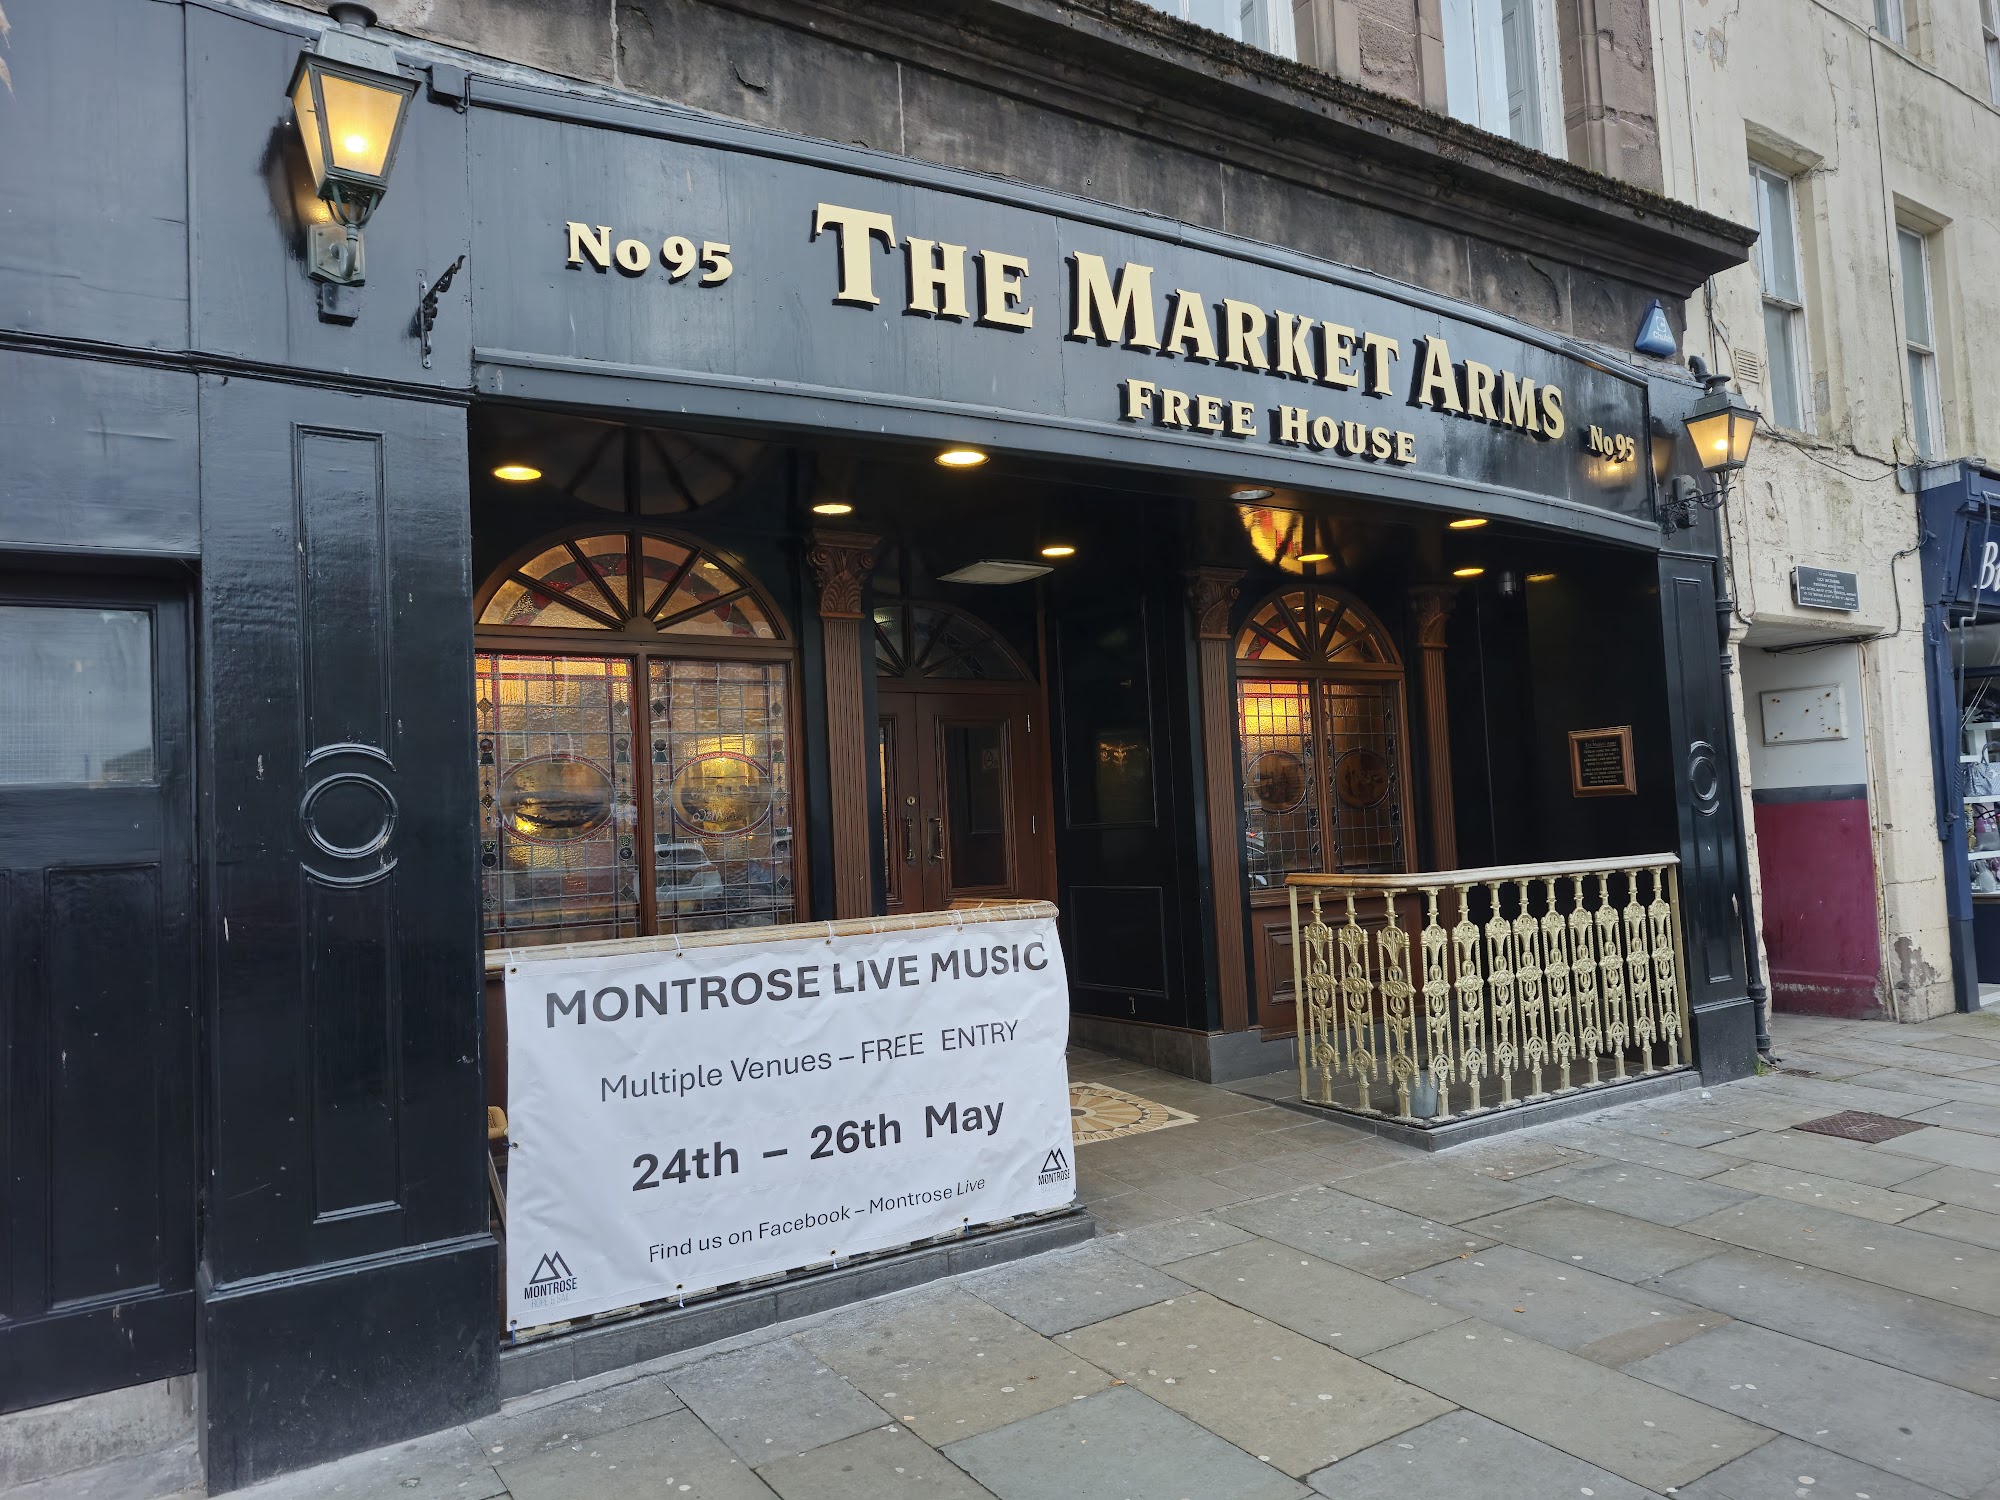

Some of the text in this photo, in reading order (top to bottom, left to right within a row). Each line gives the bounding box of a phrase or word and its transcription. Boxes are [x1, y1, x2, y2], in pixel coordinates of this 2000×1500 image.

[569, 221, 733, 282] No 95
[816, 203, 1566, 440] THE MARKET ARMS
[1652, 331, 1673, 343] Chubb
[1126, 379, 1417, 464] FREE HOUSE
[1590, 424, 1635, 462] No 95
[546, 942, 1049, 1029] MONTROSE LIVE MUSIC
[600, 1064, 722, 1102] Multiple
[731, 1053, 832, 1082] Venues
[861, 1033, 924, 1063] FREE
[941, 1020, 1019, 1051] ENTRY
[632, 1141, 740, 1191] 24th
[810, 1113, 901, 1160] 26th
[924, 1101, 1004, 1138] May
[1038, 1169, 1070, 1185] MONTROSE
[649, 1238, 692, 1262] Find
[698, 1234, 722, 1252] us
[728, 1228, 753, 1246] on
[759, 1206, 850, 1239] Facebook
[869, 1188, 953, 1214] Montrose
[956, 1177, 985, 1196] Live
[524, 1277, 577, 1299] MONTROSE
